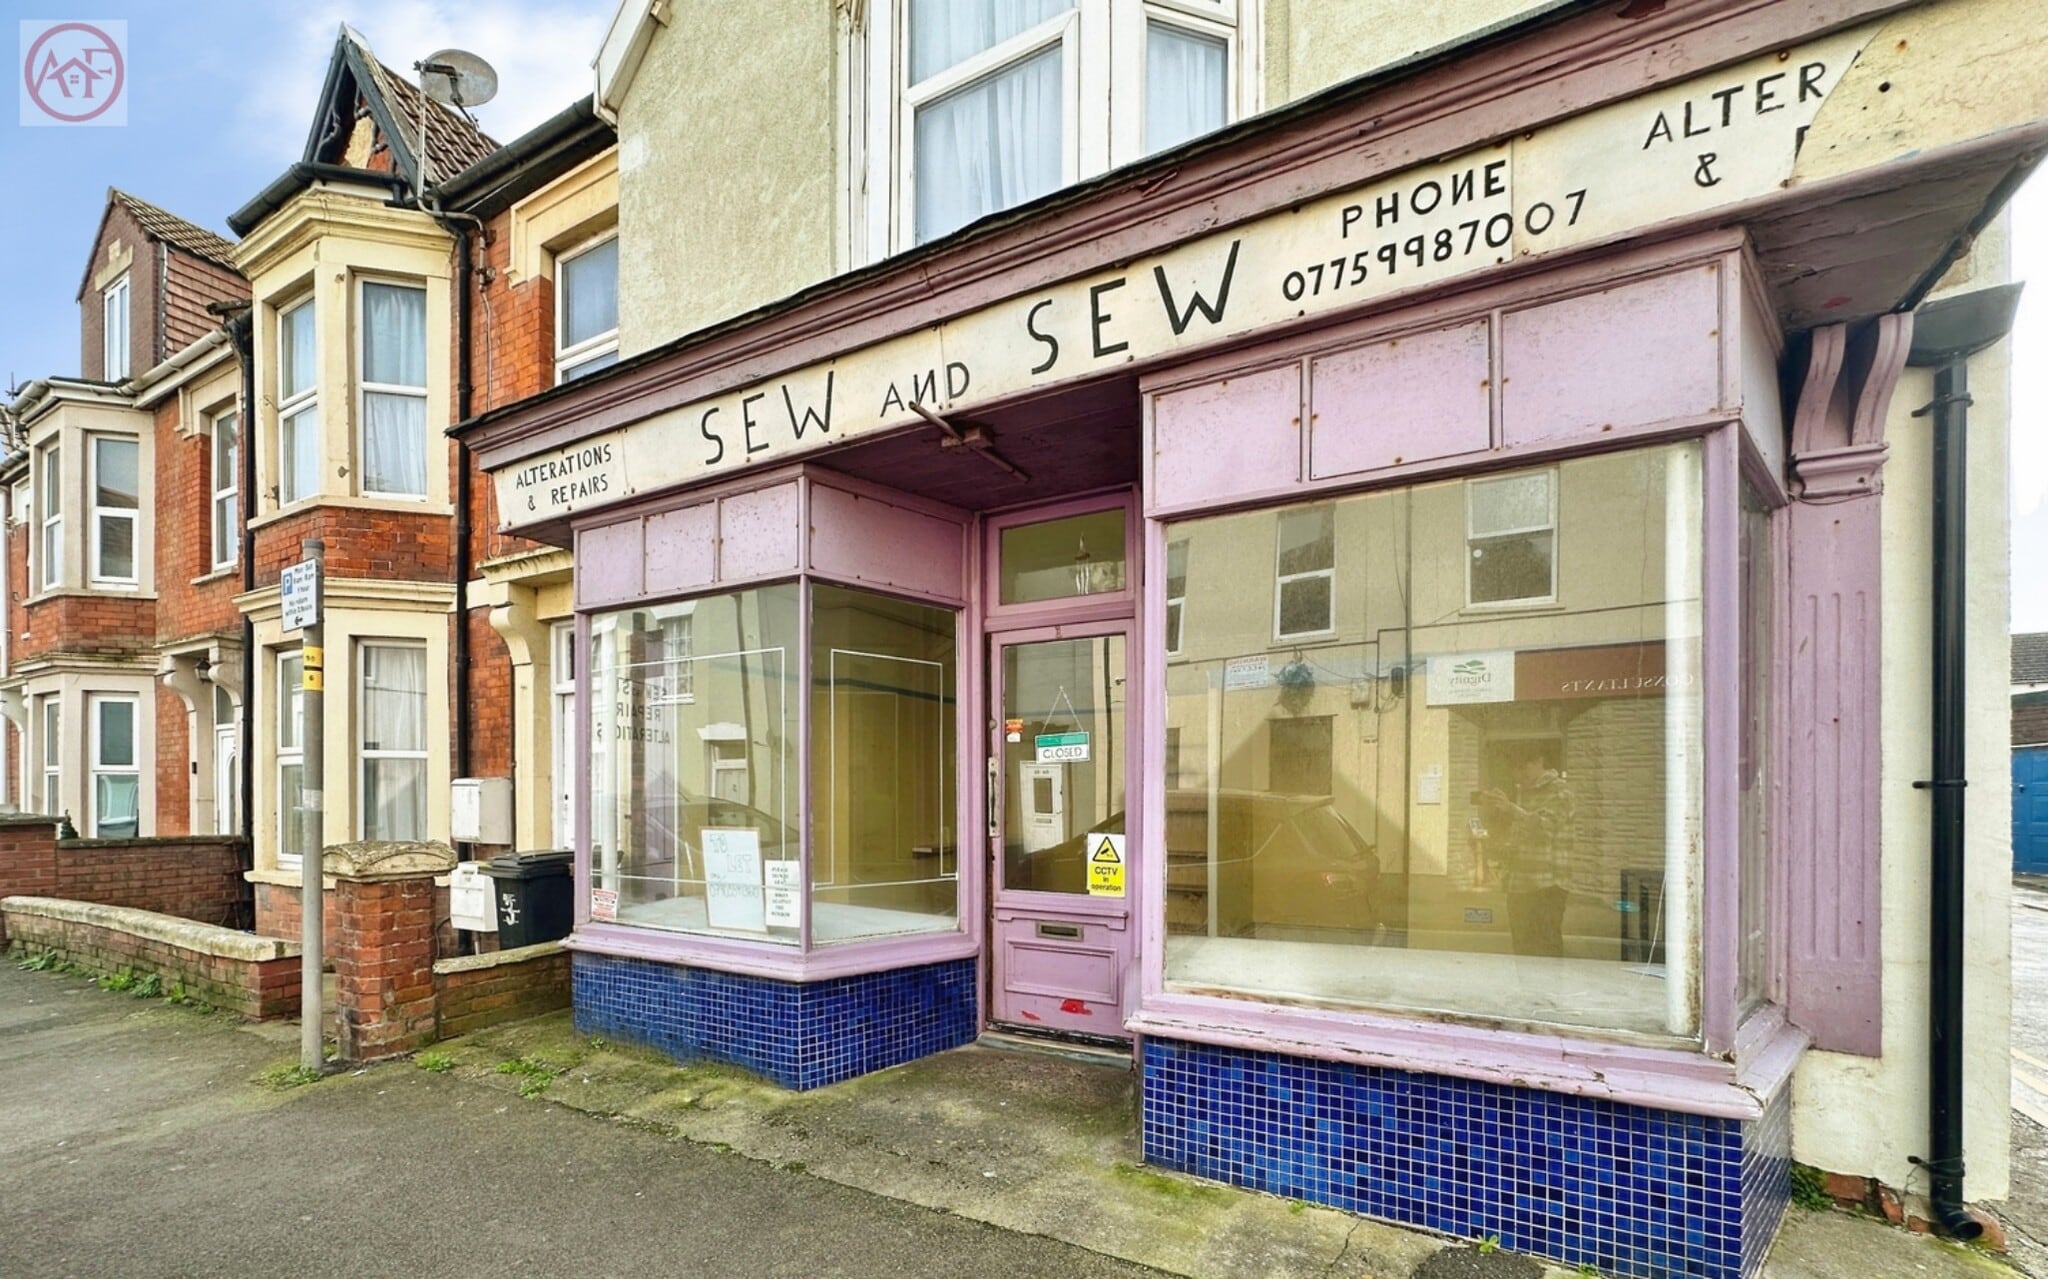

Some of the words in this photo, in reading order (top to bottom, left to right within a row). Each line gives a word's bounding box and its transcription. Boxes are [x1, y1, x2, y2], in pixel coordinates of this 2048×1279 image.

[1643, 49, 1861, 150] ALTER
[1694, 152, 1721, 187] &
[1341, 159, 1507, 239] PHONE
[1282, 188, 1587, 301] 07759987007
[701, 370, 834, 465] SEW
[880, 361, 970, 418] AND
[1026, 239, 1241, 375] SEW
[515, 443, 612, 490] ALTERATIONS
[527, 495, 536, 511] &
[551, 473, 609, 506] REPAIRS
[1043, 746, 1082, 759] CLOSED
[1094, 866, 1118, 875] CCTV
